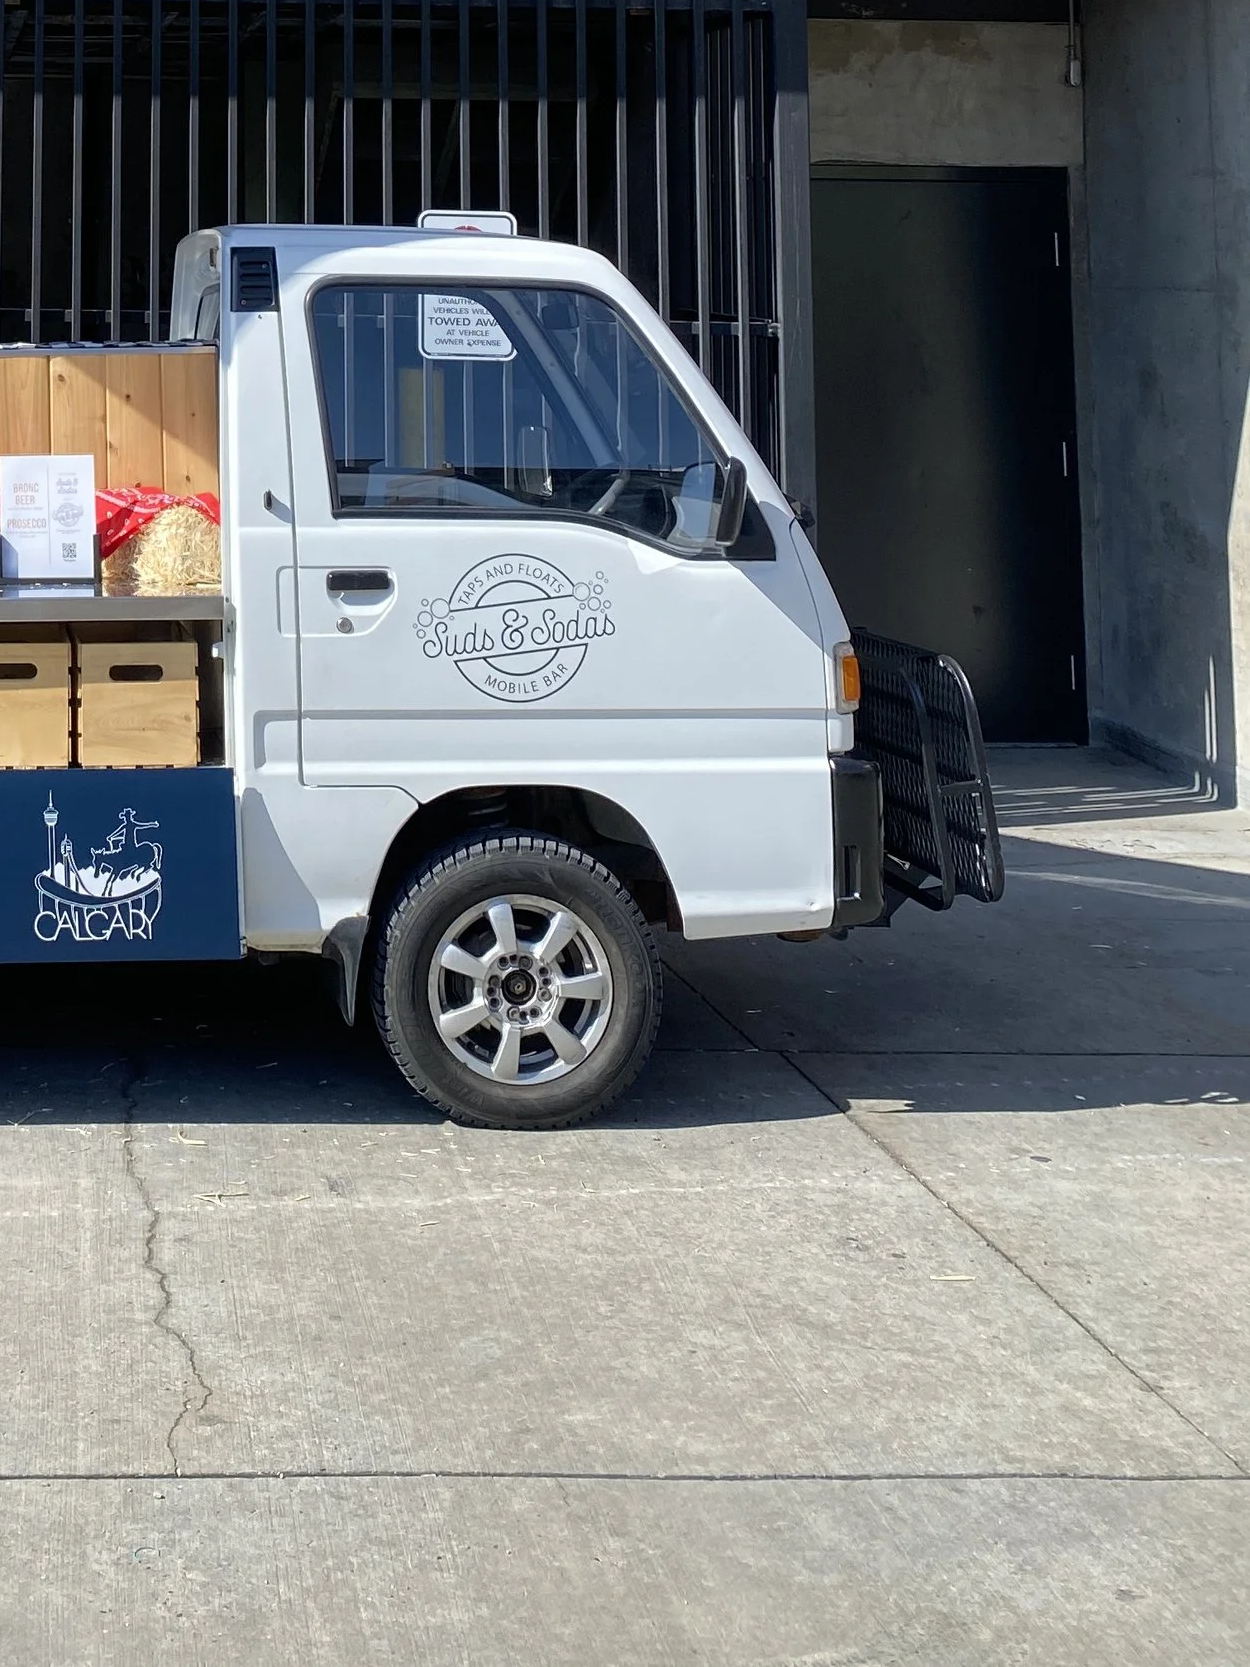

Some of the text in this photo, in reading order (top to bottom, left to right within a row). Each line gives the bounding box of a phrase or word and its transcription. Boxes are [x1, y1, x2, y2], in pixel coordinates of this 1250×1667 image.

[428, 317, 471, 326] TOWED
[459, 329, 490, 337] VEHICLE
[434, 338, 464, 346] OWNER
[15, 495, 36, 505] BEER
[6, 518, 47, 529] PROSECCO
[457, 563, 565, 607] TAPS AND FLOATS
[422, 608, 616, 659] Suds & Sodas
[484, 662, 569, 694] MOBILE BAR
[34, 908, 159, 941] CALGARY
